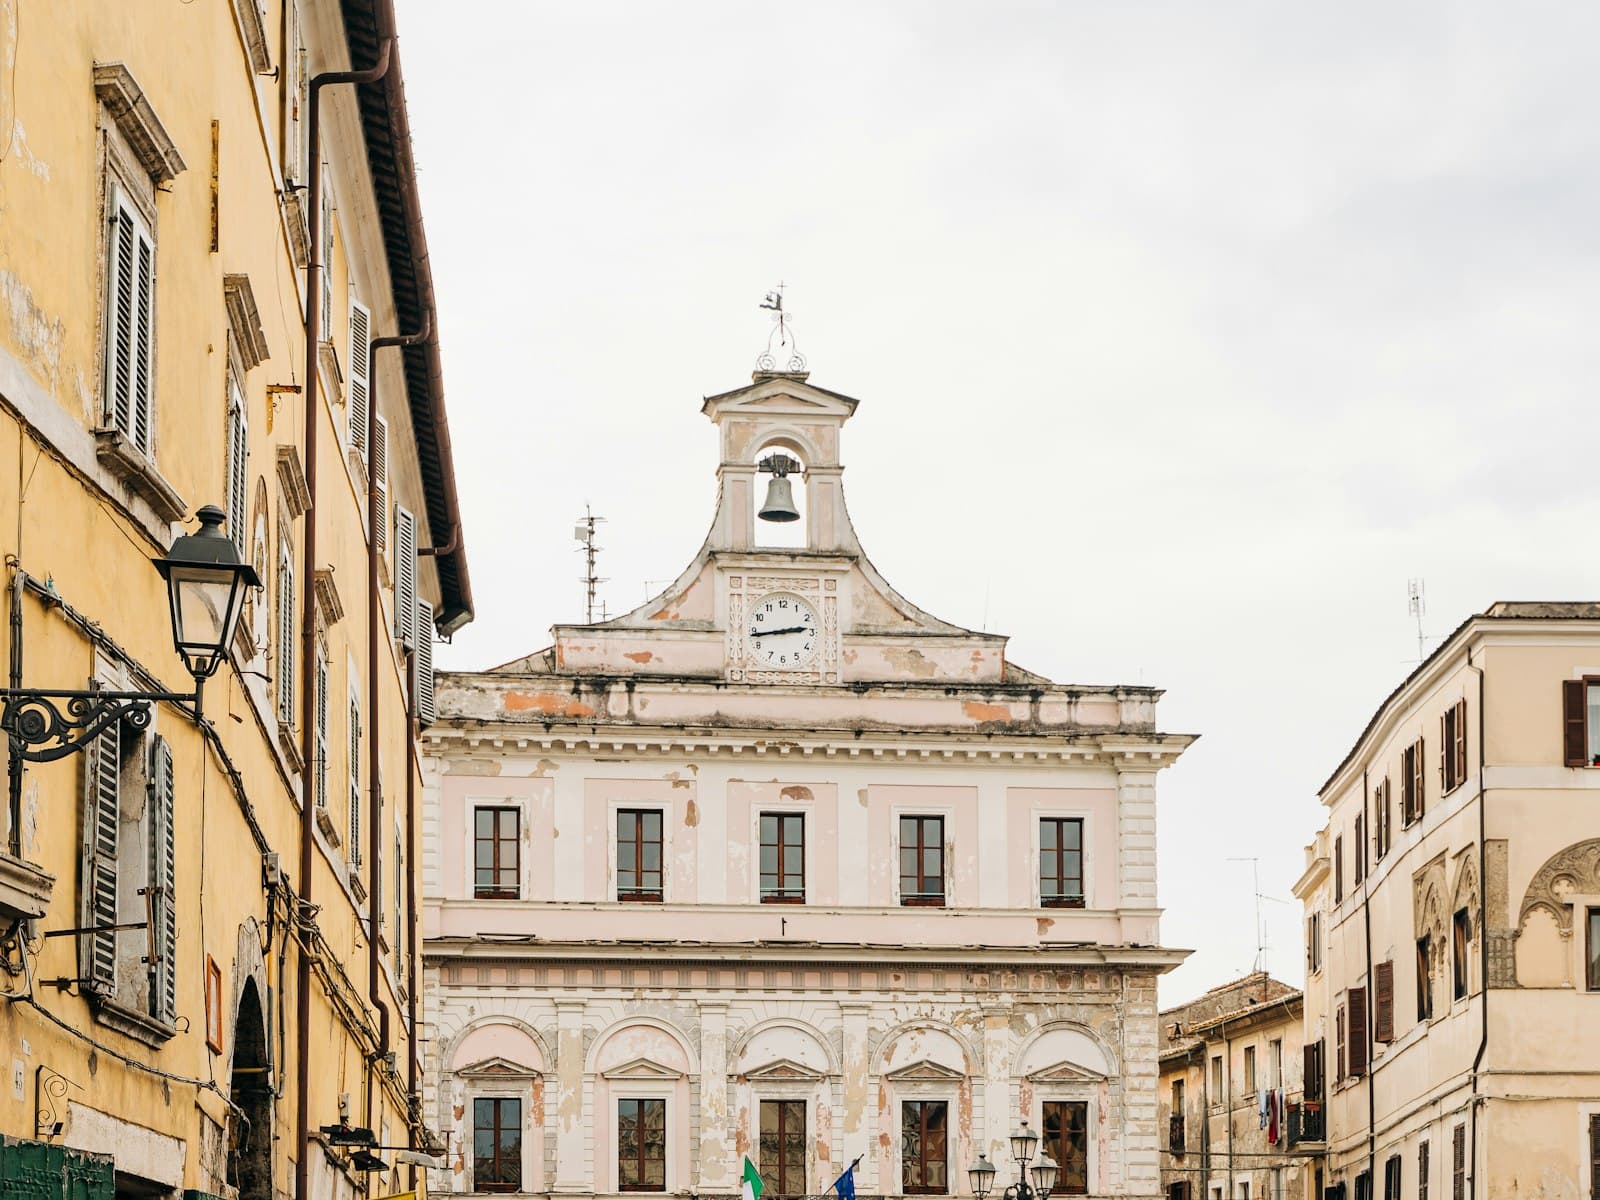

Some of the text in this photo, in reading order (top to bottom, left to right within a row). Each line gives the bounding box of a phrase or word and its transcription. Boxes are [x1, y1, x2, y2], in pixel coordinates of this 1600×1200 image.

[765, 604, 773, 612] 11
[779, 600, 788, 609] 12
[794, 605, 799, 613] 1
[755, 613, 764, 622] 10
[804, 613, 810, 622] 2
[751, 626, 757, 634] 9
[809, 628, 815, 637] 3
[756, 641, 761, 650] 8
[804, 642, 810, 651] 4
[768, 651, 774, 660] 7
[780, 655, 786, 664] 6
[794, 652, 800, 660] 5
